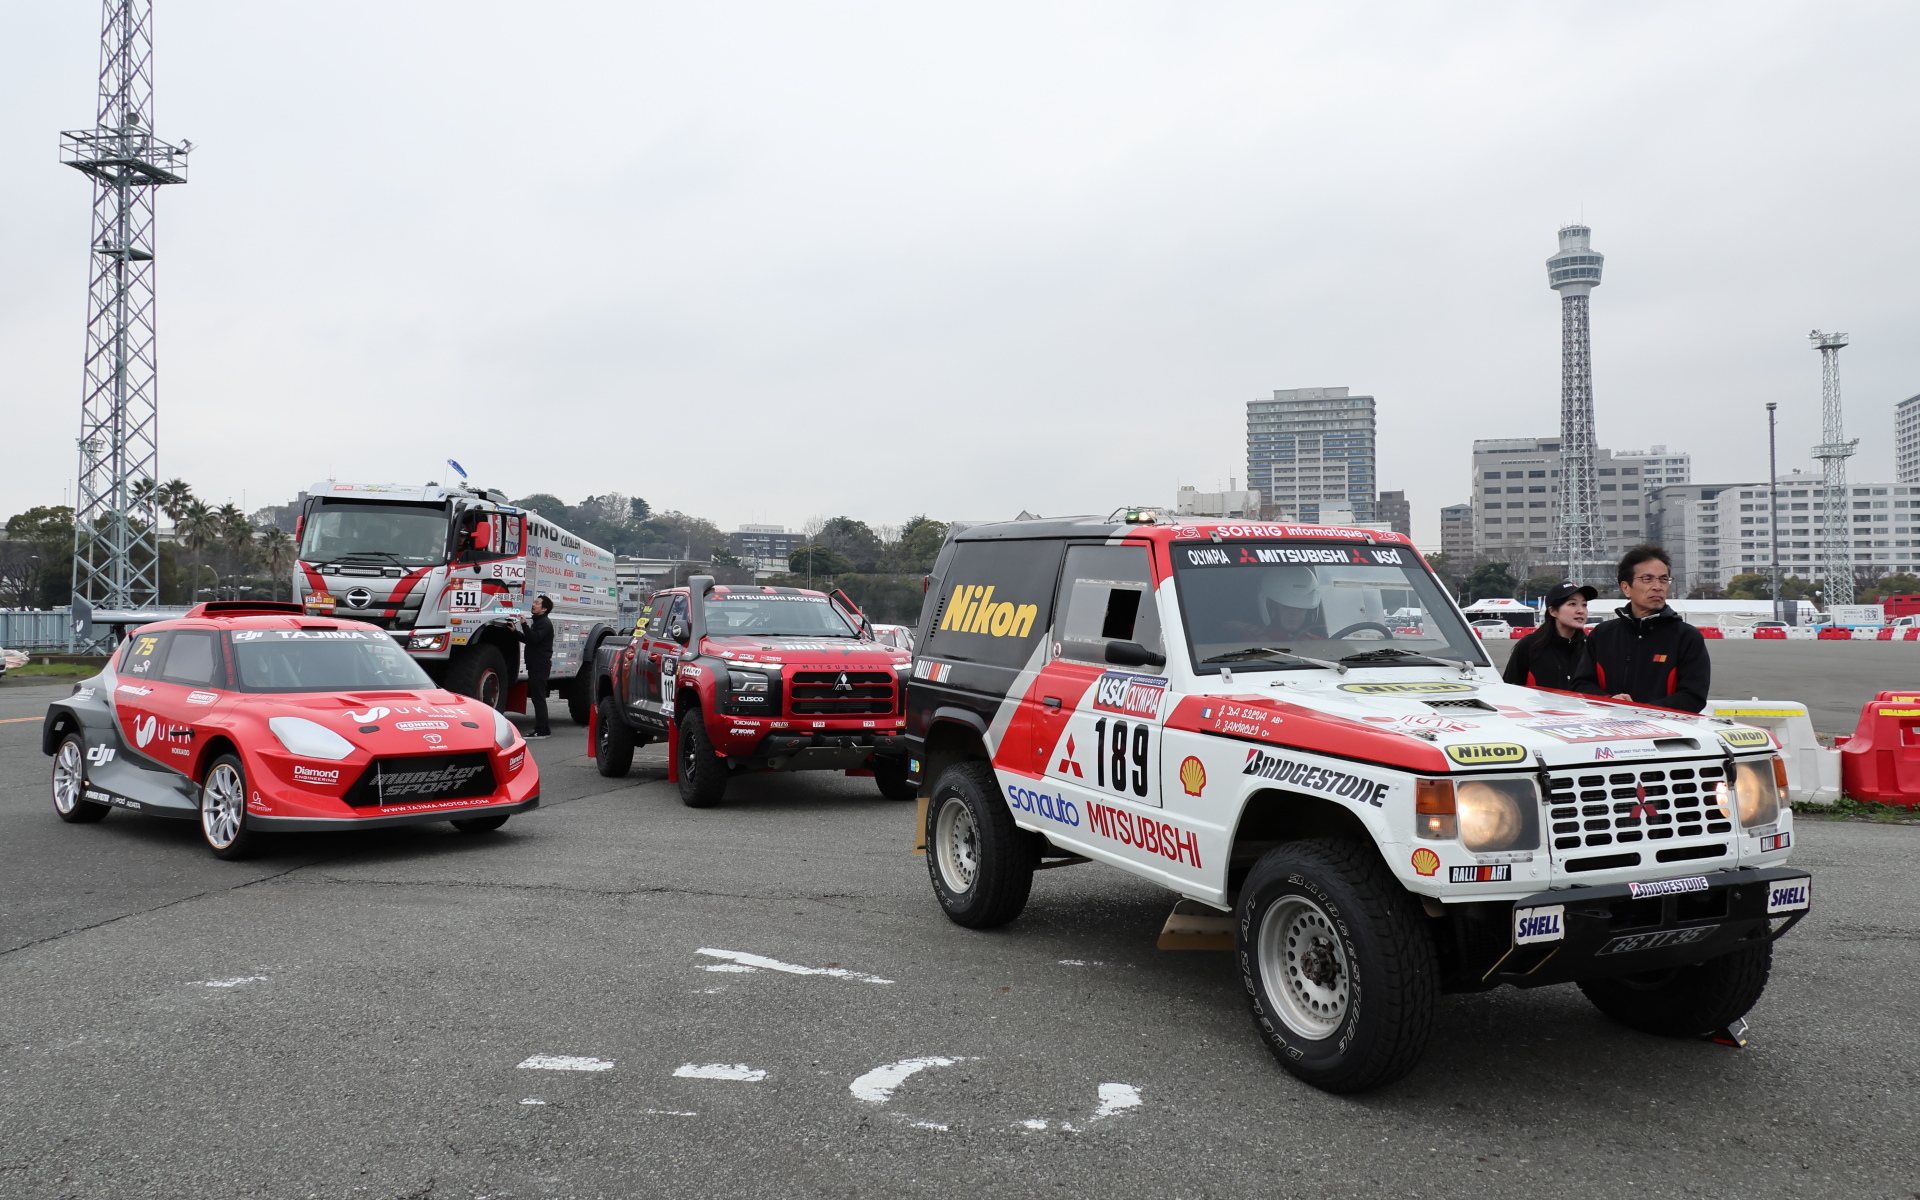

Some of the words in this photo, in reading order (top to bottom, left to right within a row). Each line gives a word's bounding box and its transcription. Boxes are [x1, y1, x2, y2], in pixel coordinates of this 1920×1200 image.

[1217, 526, 1282, 537] SOFRIG
[1285, 526, 1364, 540] Informatique
[564, 554, 580, 566] CTC
[1187, 548, 1230, 566] OLYMPIA
[1256, 549, 1350, 564] MITSUBISHI
[456, 592, 476, 606] 511
[787, 596, 828, 604] MOTORS
[940, 584, 1038, 638] Nikon
[276, 631, 368, 640] TAJIMA
[134, 638, 158, 656] 75
[914, 660, 933, 680] RALLI
[936, 664, 952, 684] ART
[1358, 684, 1461, 692] Nikon
[1126, 686, 1162, 714] OLYMPIA
[394, 706, 470, 716] UKINE
[1226, 706, 1240, 716] DA
[1728, 729, 1764, 742] Nikon
[172, 747, 190, 756] HOKKAIDO
[1095, 717, 1149, 798] 189
[1457, 746, 1518, 758] Nikon
[294, 774, 337, 783] ENGINEERING
[368, 764, 486, 786] monster
[1242, 748, 1390, 808] BRIDGESTONE
[383, 778, 468, 796] SPORT
[380, 800, 490, 813] WWW.TAJIMA-MOTOR.COM
[1008, 784, 1080, 827] sonauto
[1086, 800, 1202, 869] MITSUBISHI
[1452, 866, 1478, 882] RALLI
[1490, 866, 1508, 880] ART
[1630, 876, 1708, 898] BRIDGESTONE
[1770, 886, 1806, 907] SHELL
[1518, 914, 1560, 938] SHELL
[1612, 935, 1645, 952] 66
[1674, 927, 1706, 944] 95
